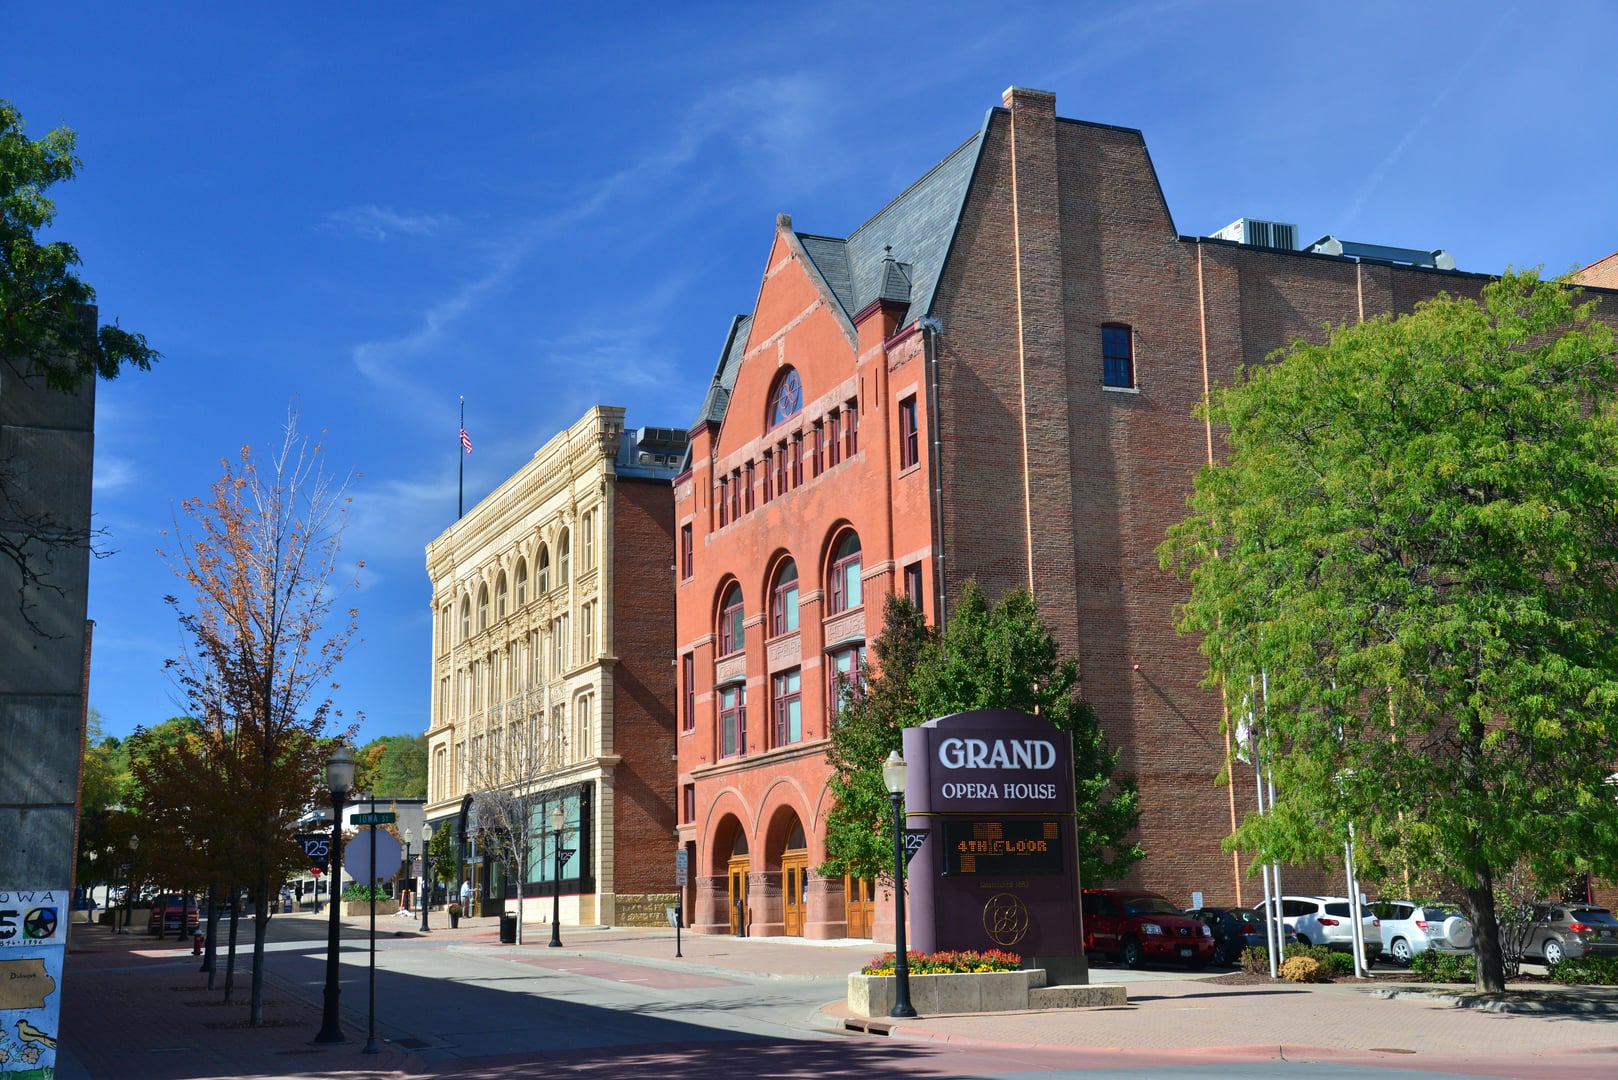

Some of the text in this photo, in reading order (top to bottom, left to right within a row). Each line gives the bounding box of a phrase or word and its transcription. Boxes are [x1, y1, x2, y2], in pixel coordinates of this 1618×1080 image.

[938, 738, 1056, 769] GRAND
[942, 783, 1056, 799] OPERA HOUSE
[359, 814, 378, 824] IOWA
[304, 840, 330, 856] 125
[904, 834, 925, 849] 125
[958, 840, 1047, 852] 4TH FLOOR
